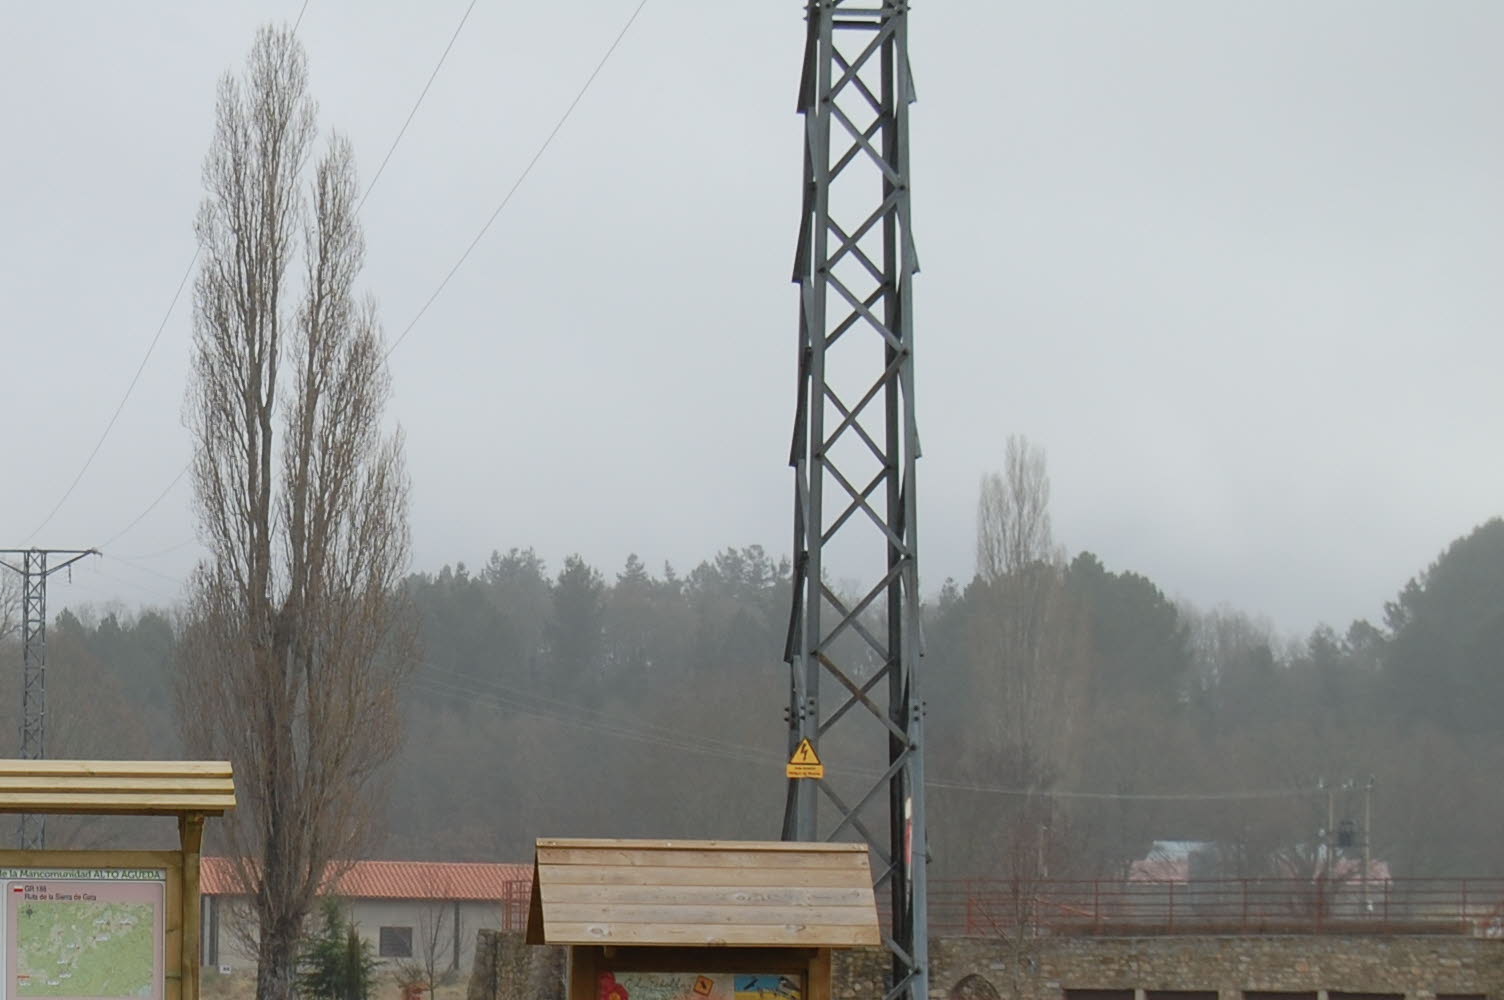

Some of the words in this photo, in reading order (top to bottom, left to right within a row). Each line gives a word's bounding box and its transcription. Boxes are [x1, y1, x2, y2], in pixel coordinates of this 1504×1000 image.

[10, 869, 18, 878] la
[20, 869, 91, 878] Mancomunidad
[94, 870, 119, 878] ALTO
